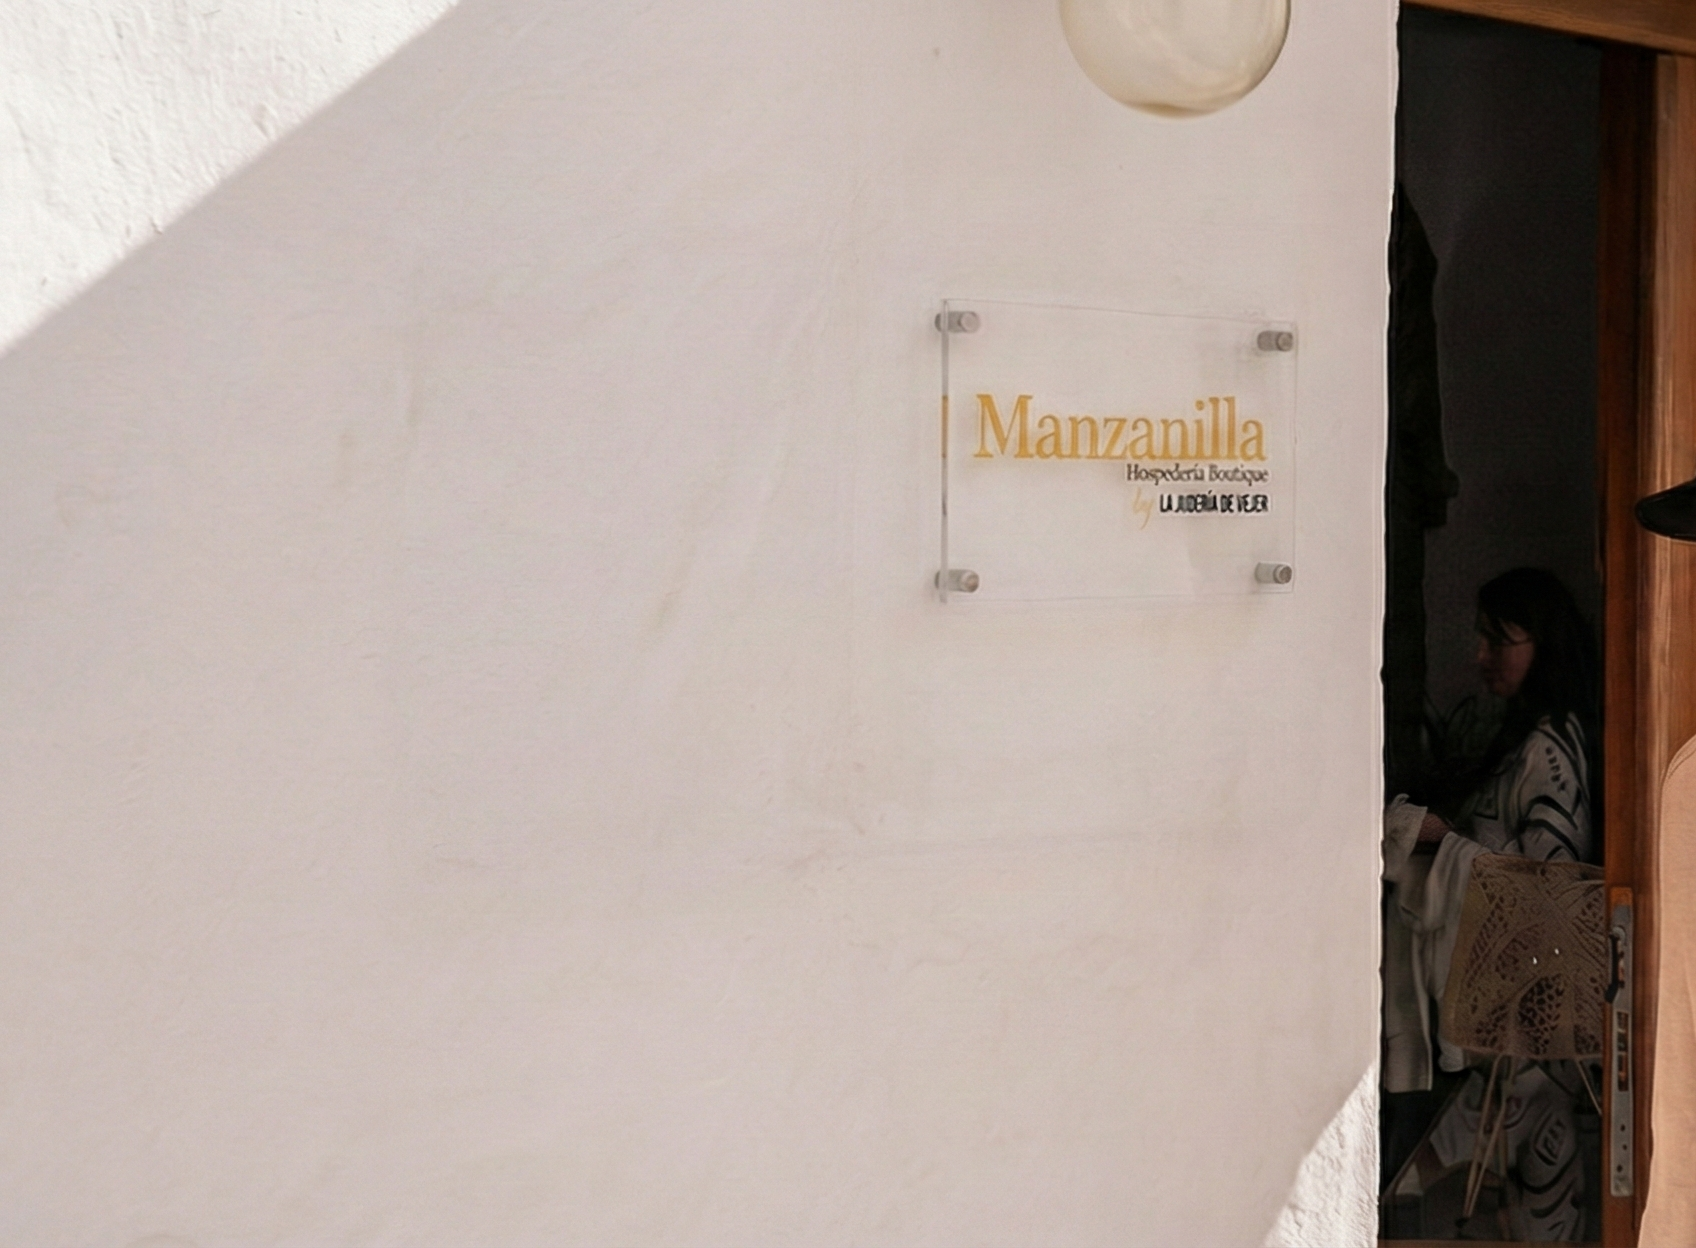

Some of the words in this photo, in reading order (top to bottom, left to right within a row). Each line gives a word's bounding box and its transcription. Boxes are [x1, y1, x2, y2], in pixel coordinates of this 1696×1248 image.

[973, 393, 1268, 462] Manzanilla
[1208, 463, 1270, 487] Boutique
[1159, 494, 1173, 513] LA
[1220, 494, 1235, 513] DE
